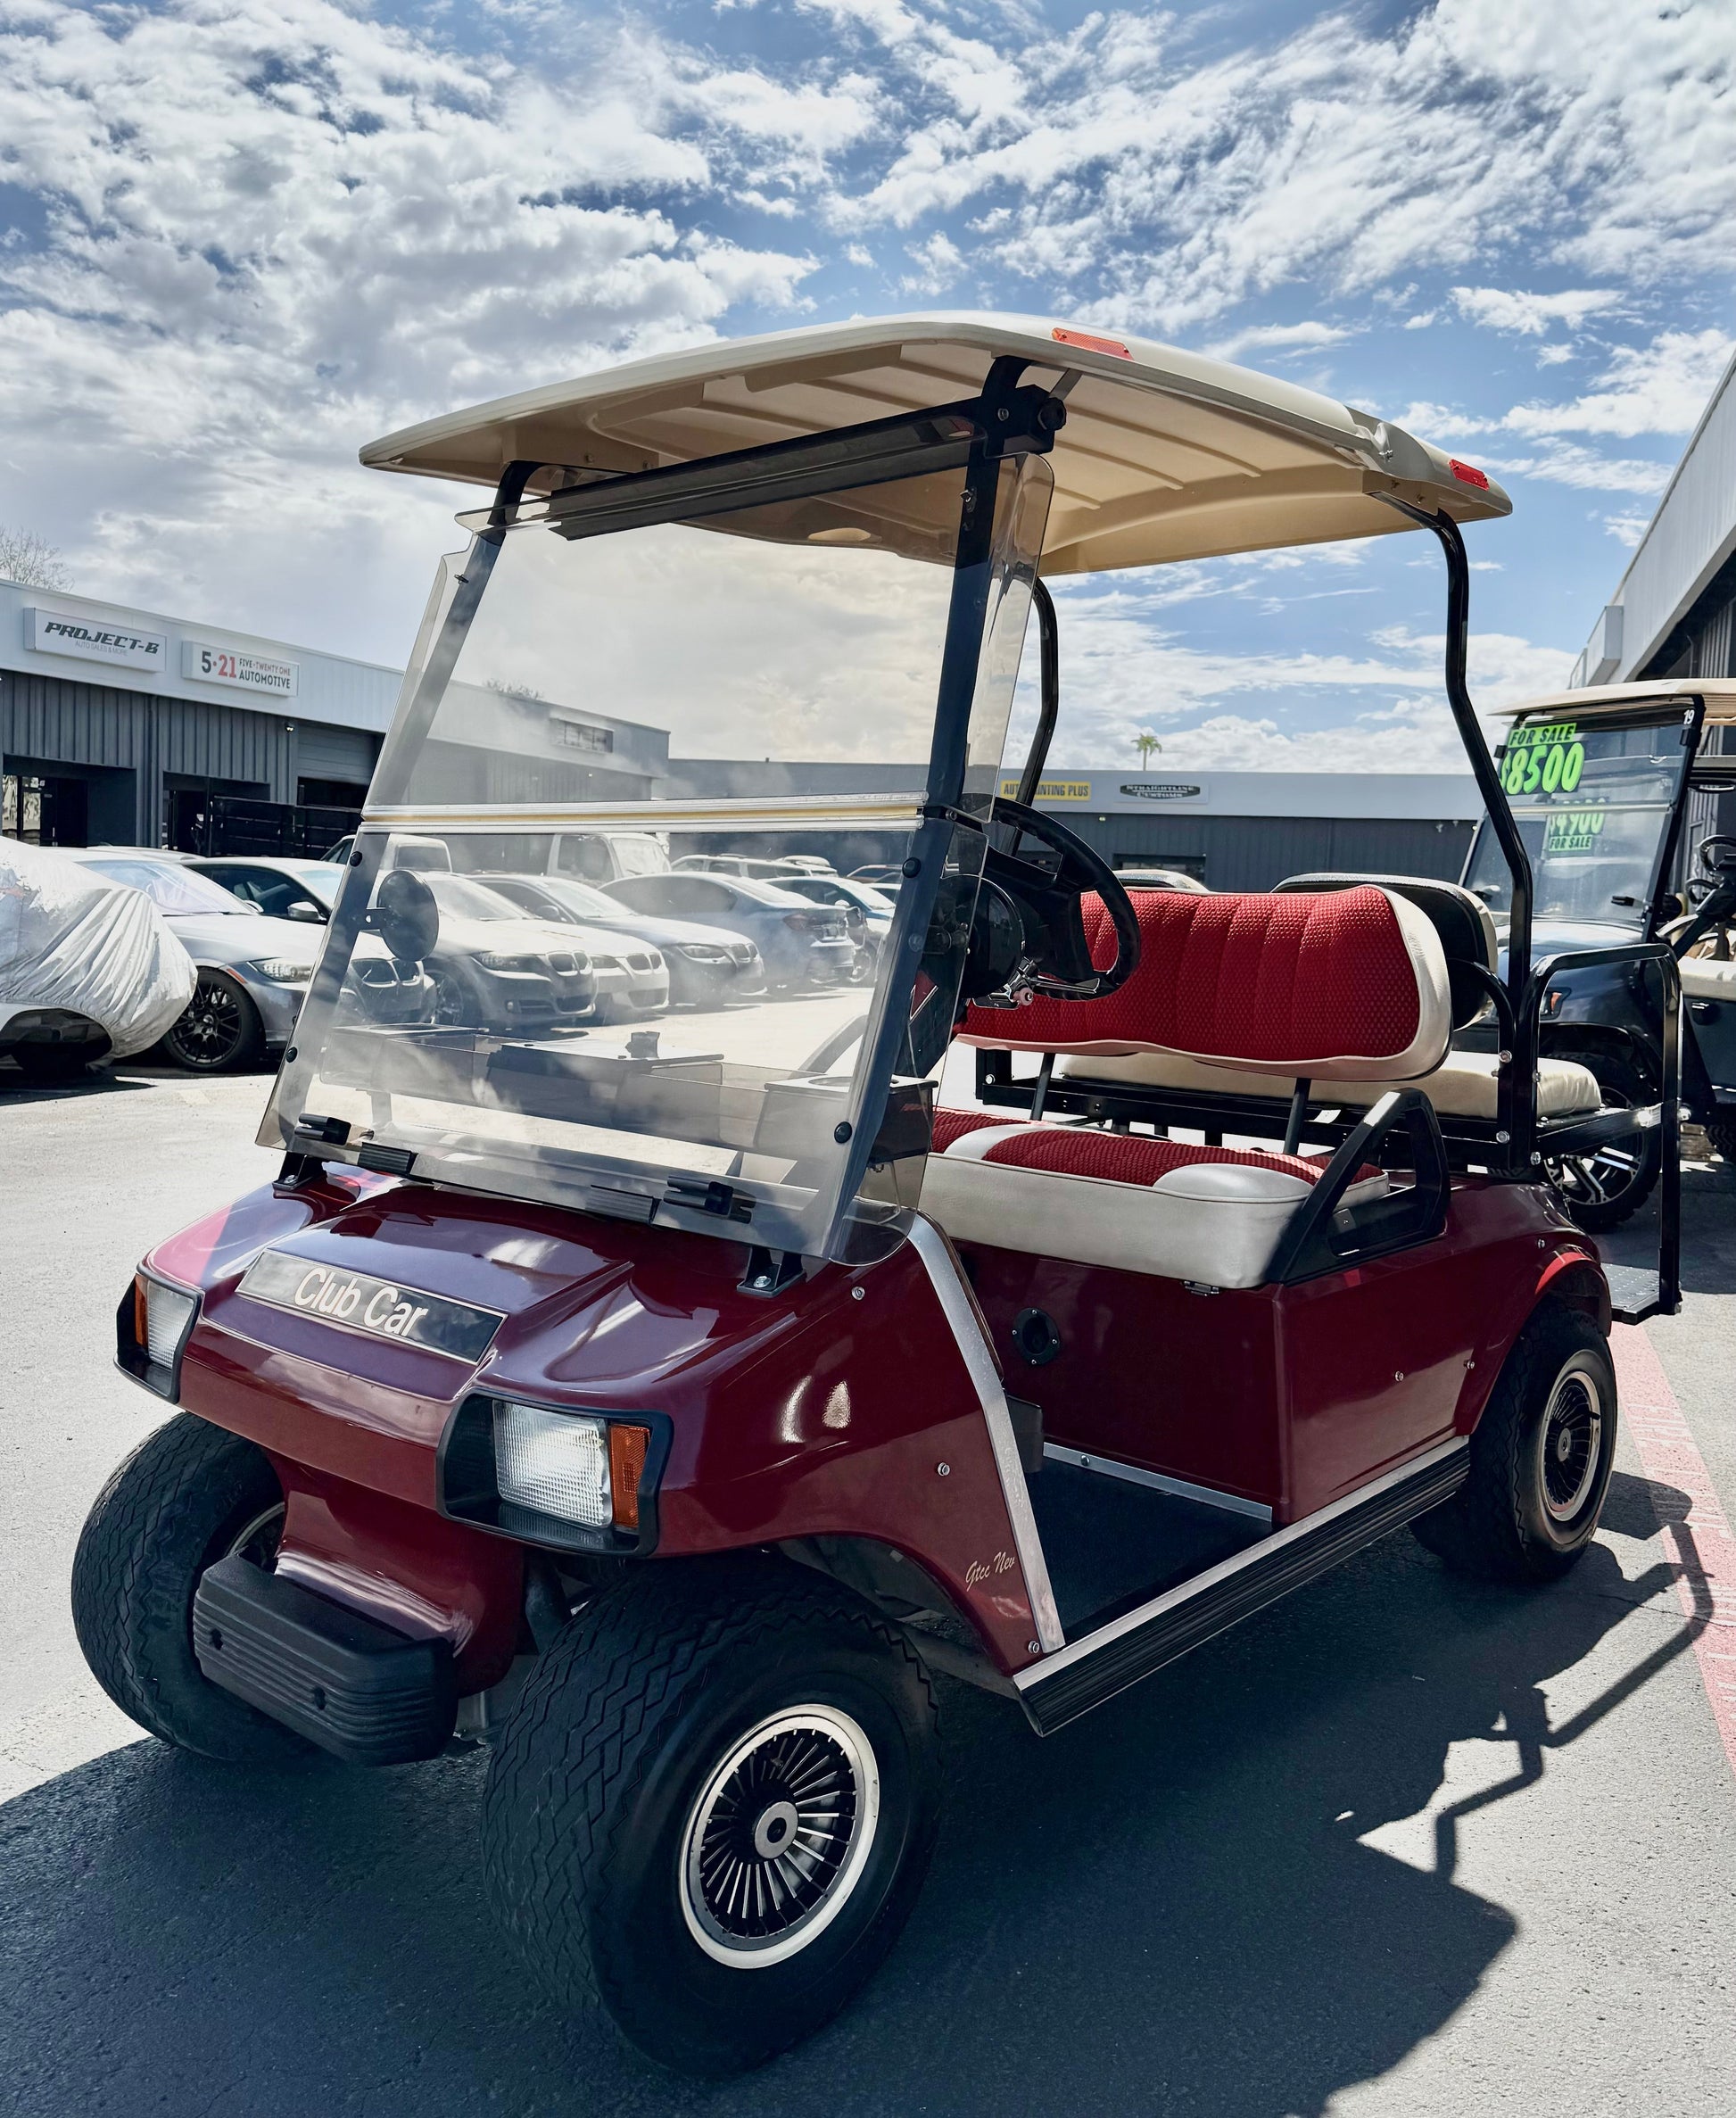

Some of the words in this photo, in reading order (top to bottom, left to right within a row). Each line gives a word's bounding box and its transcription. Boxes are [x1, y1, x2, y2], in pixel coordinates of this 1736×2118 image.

[45, 622, 160, 654] PROJECT-B
[75, 640, 91, 649] AUTO
[91, 642, 108, 652] SALES
[112, 647, 128, 656] MORE
[239, 669, 291, 689] AUTOMOTIVE
[1683, 709, 1695, 724] 19
[1510, 730, 1536, 746] FOR
[1540, 725, 1575, 742] SALE
[1004, 783, 1021, 795] AUT
[1068, 785, 1088, 797] PLUS
[1550, 837, 1567, 849] FOR
[1569, 836, 1591, 848] SALE
[294, 1267, 361, 1320] Club
[363, 1286, 428, 1336] Car
